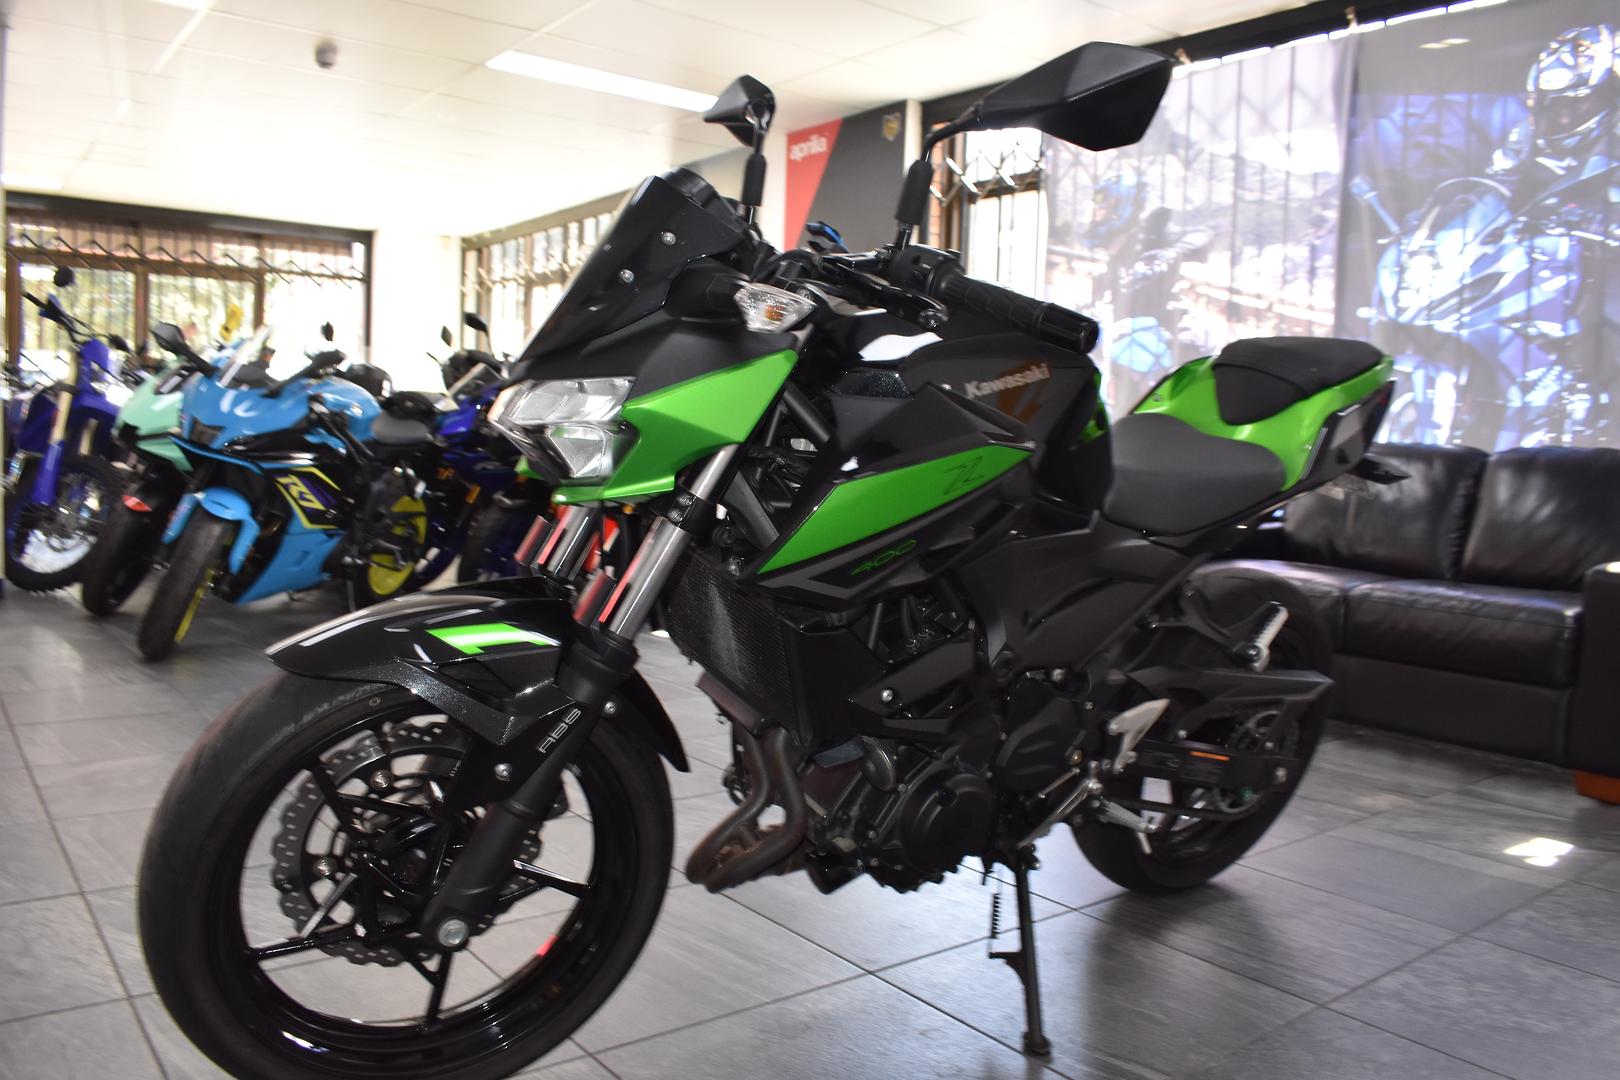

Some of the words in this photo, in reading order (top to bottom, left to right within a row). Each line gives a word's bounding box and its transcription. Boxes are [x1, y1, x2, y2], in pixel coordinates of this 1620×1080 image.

[789, 135, 828, 162] aprilia
[964, 362, 1051, 400] Kawasaki
[850, 539, 917, 576] 400
[538, 708, 582, 753] ABS
